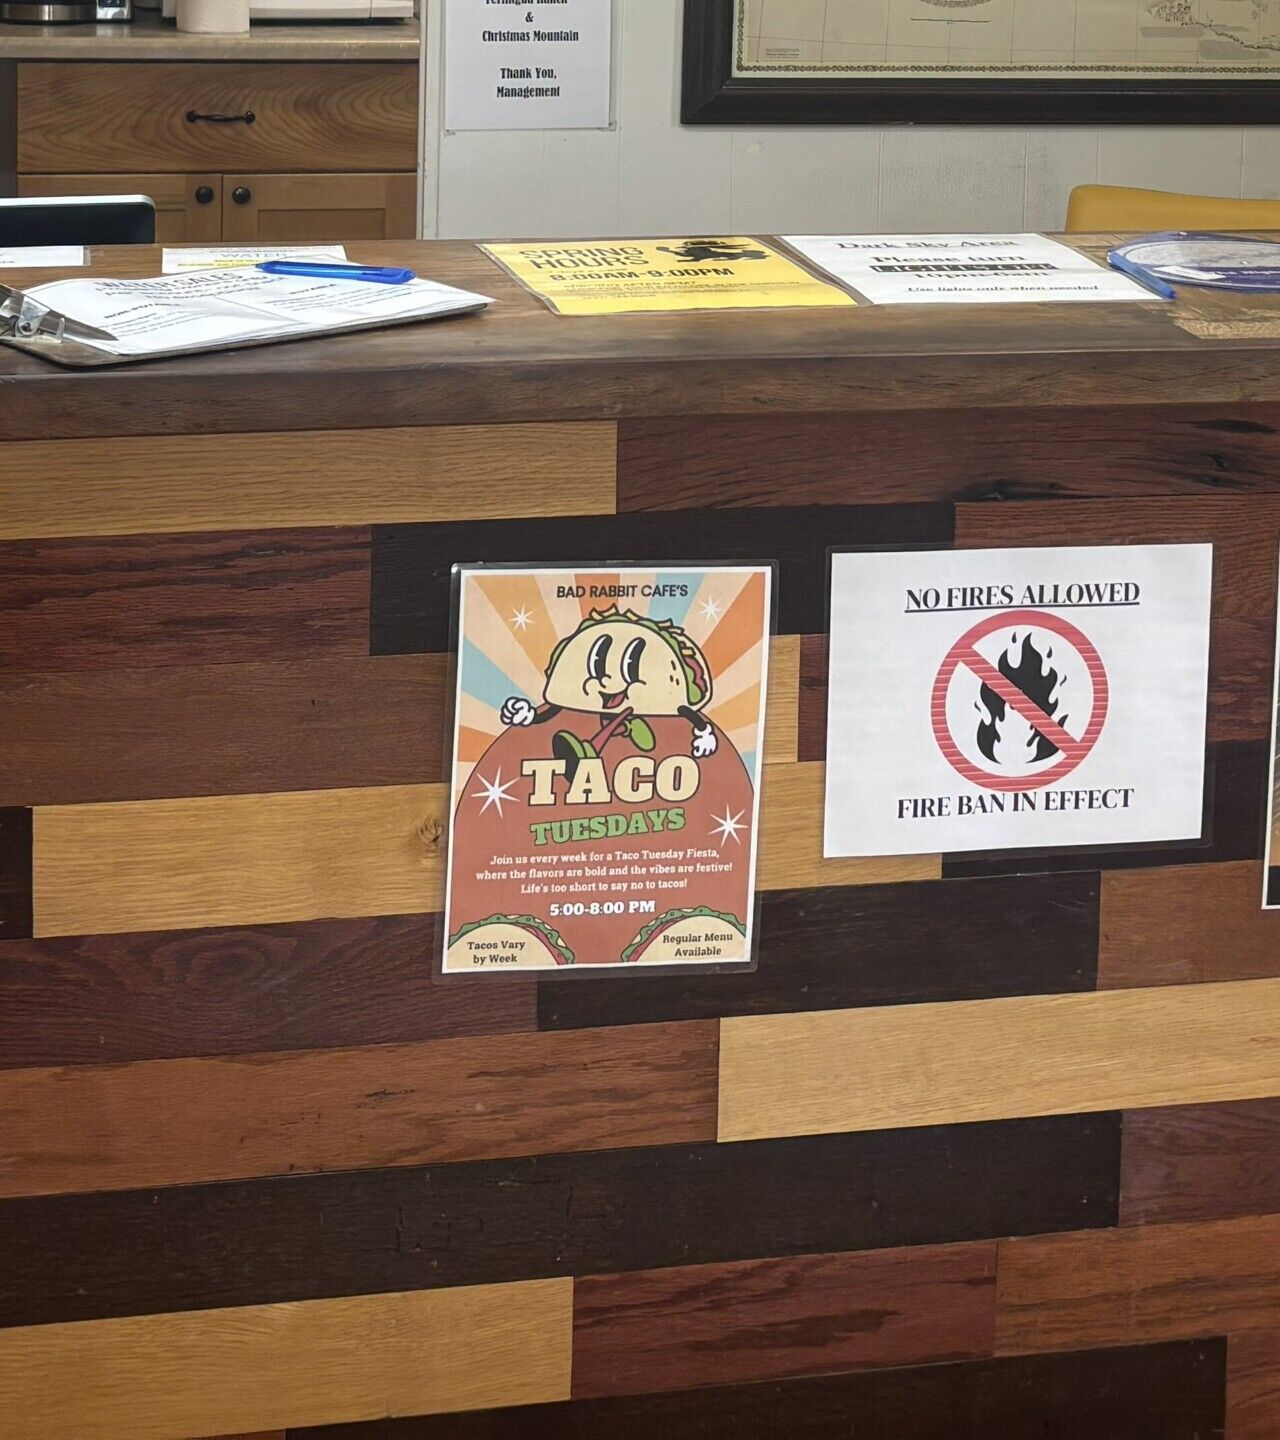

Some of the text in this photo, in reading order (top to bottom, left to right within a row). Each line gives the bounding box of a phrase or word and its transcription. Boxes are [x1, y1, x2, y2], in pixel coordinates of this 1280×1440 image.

[525, 12, 534, 22] &
[483, 31, 578, 42] Christmas Mountain
[500, 68, 557, 80] Thank You,
[497, 86, 560, 98] Management
[520, 247, 644, 260] SPRING
[527, 256, 648, 269] HOURS
[556, 584, 688, 598] BAD RABBIT CAFE'S
[906, 582, 1140, 610] NO FIRES ALLOWED
[521, 754, 701, 807] TACO
[897, 788, 1135, 819] FIRE BAN IN EFFECT
[530, 807, 687, 847] TUESDAYS
[550, 900, 655, 916] 5:00-8:00 PM
[662, 932, 733, 944] Regular Menu
[467, 939, 525, 951] Tacos Vary
[675, 946, 721, 957] Available
[473, 952, 517, 965] by Week
